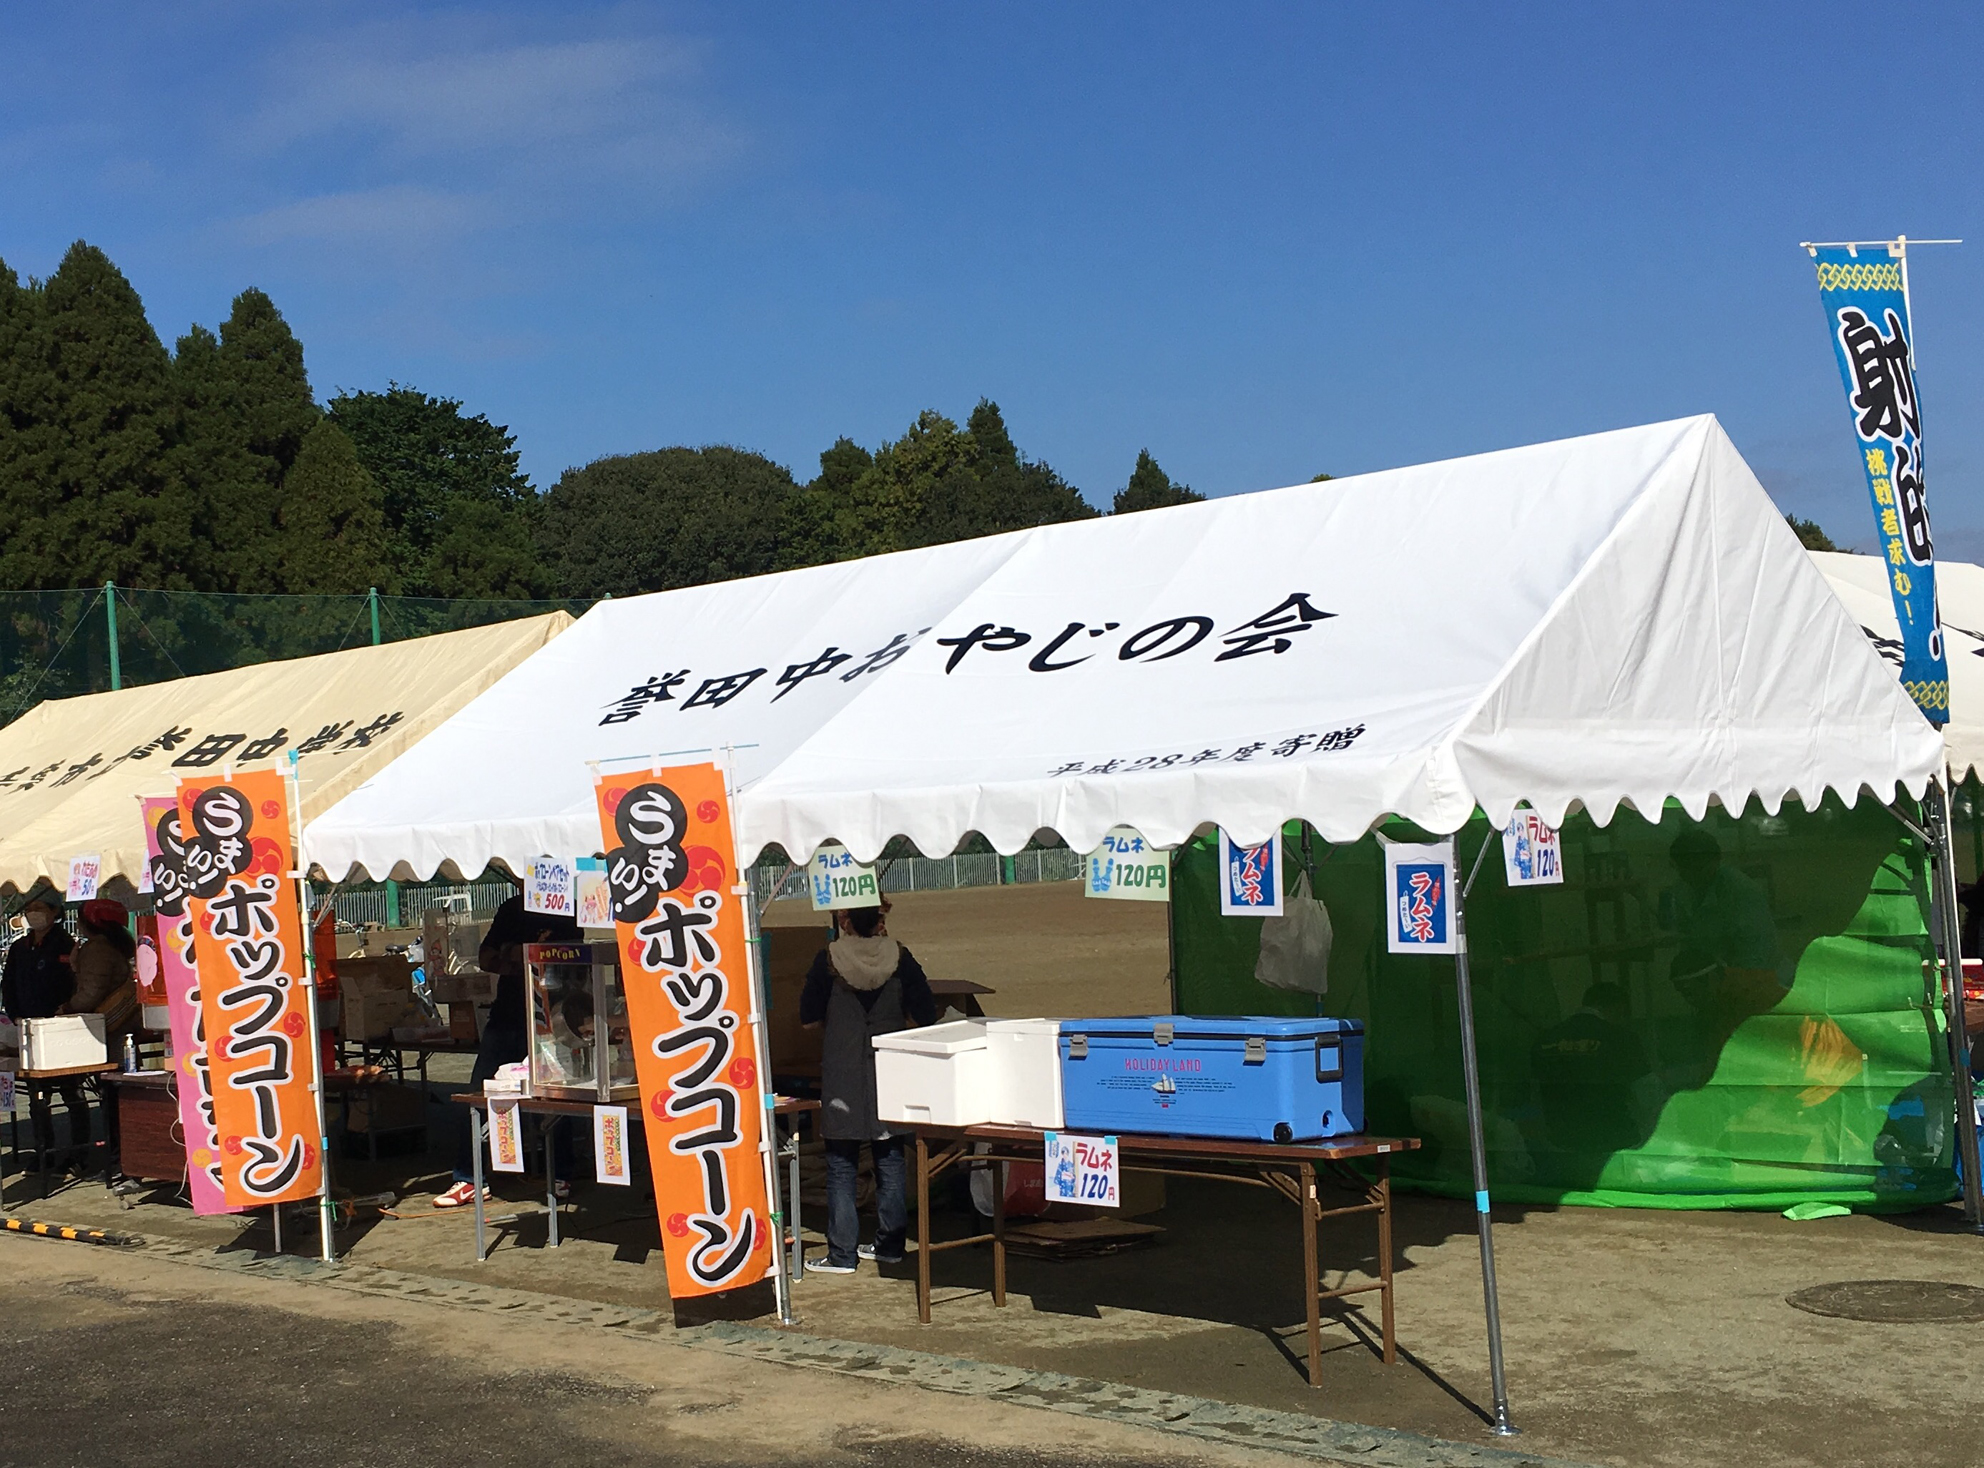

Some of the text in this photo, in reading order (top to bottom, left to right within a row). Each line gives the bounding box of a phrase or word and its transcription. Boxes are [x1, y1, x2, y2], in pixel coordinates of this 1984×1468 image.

[598, 592, 1338, 728] 誉田中おやじの会
[1047, 724, 1366, 779] 平成28年度寄贈
[1102, 836, 1145, 854] ラムネ
[818, 852, 853, 869] ラムネ
[832, 873, 876, 898] 120円
[1115, 863, 1167, 889] 120円
[1409, 871, 1435, 944] ラムネ
[209, 874, 305, 1197] ポップコーン
[1125, 1058, 1201, 1072] HOLIDAY LAND
[636, 890, 757, 1285] ポップコーン
[1076, 1142, 1113, 1172] ラムネ
[1080, 1173, 1115, 1201] 120円
